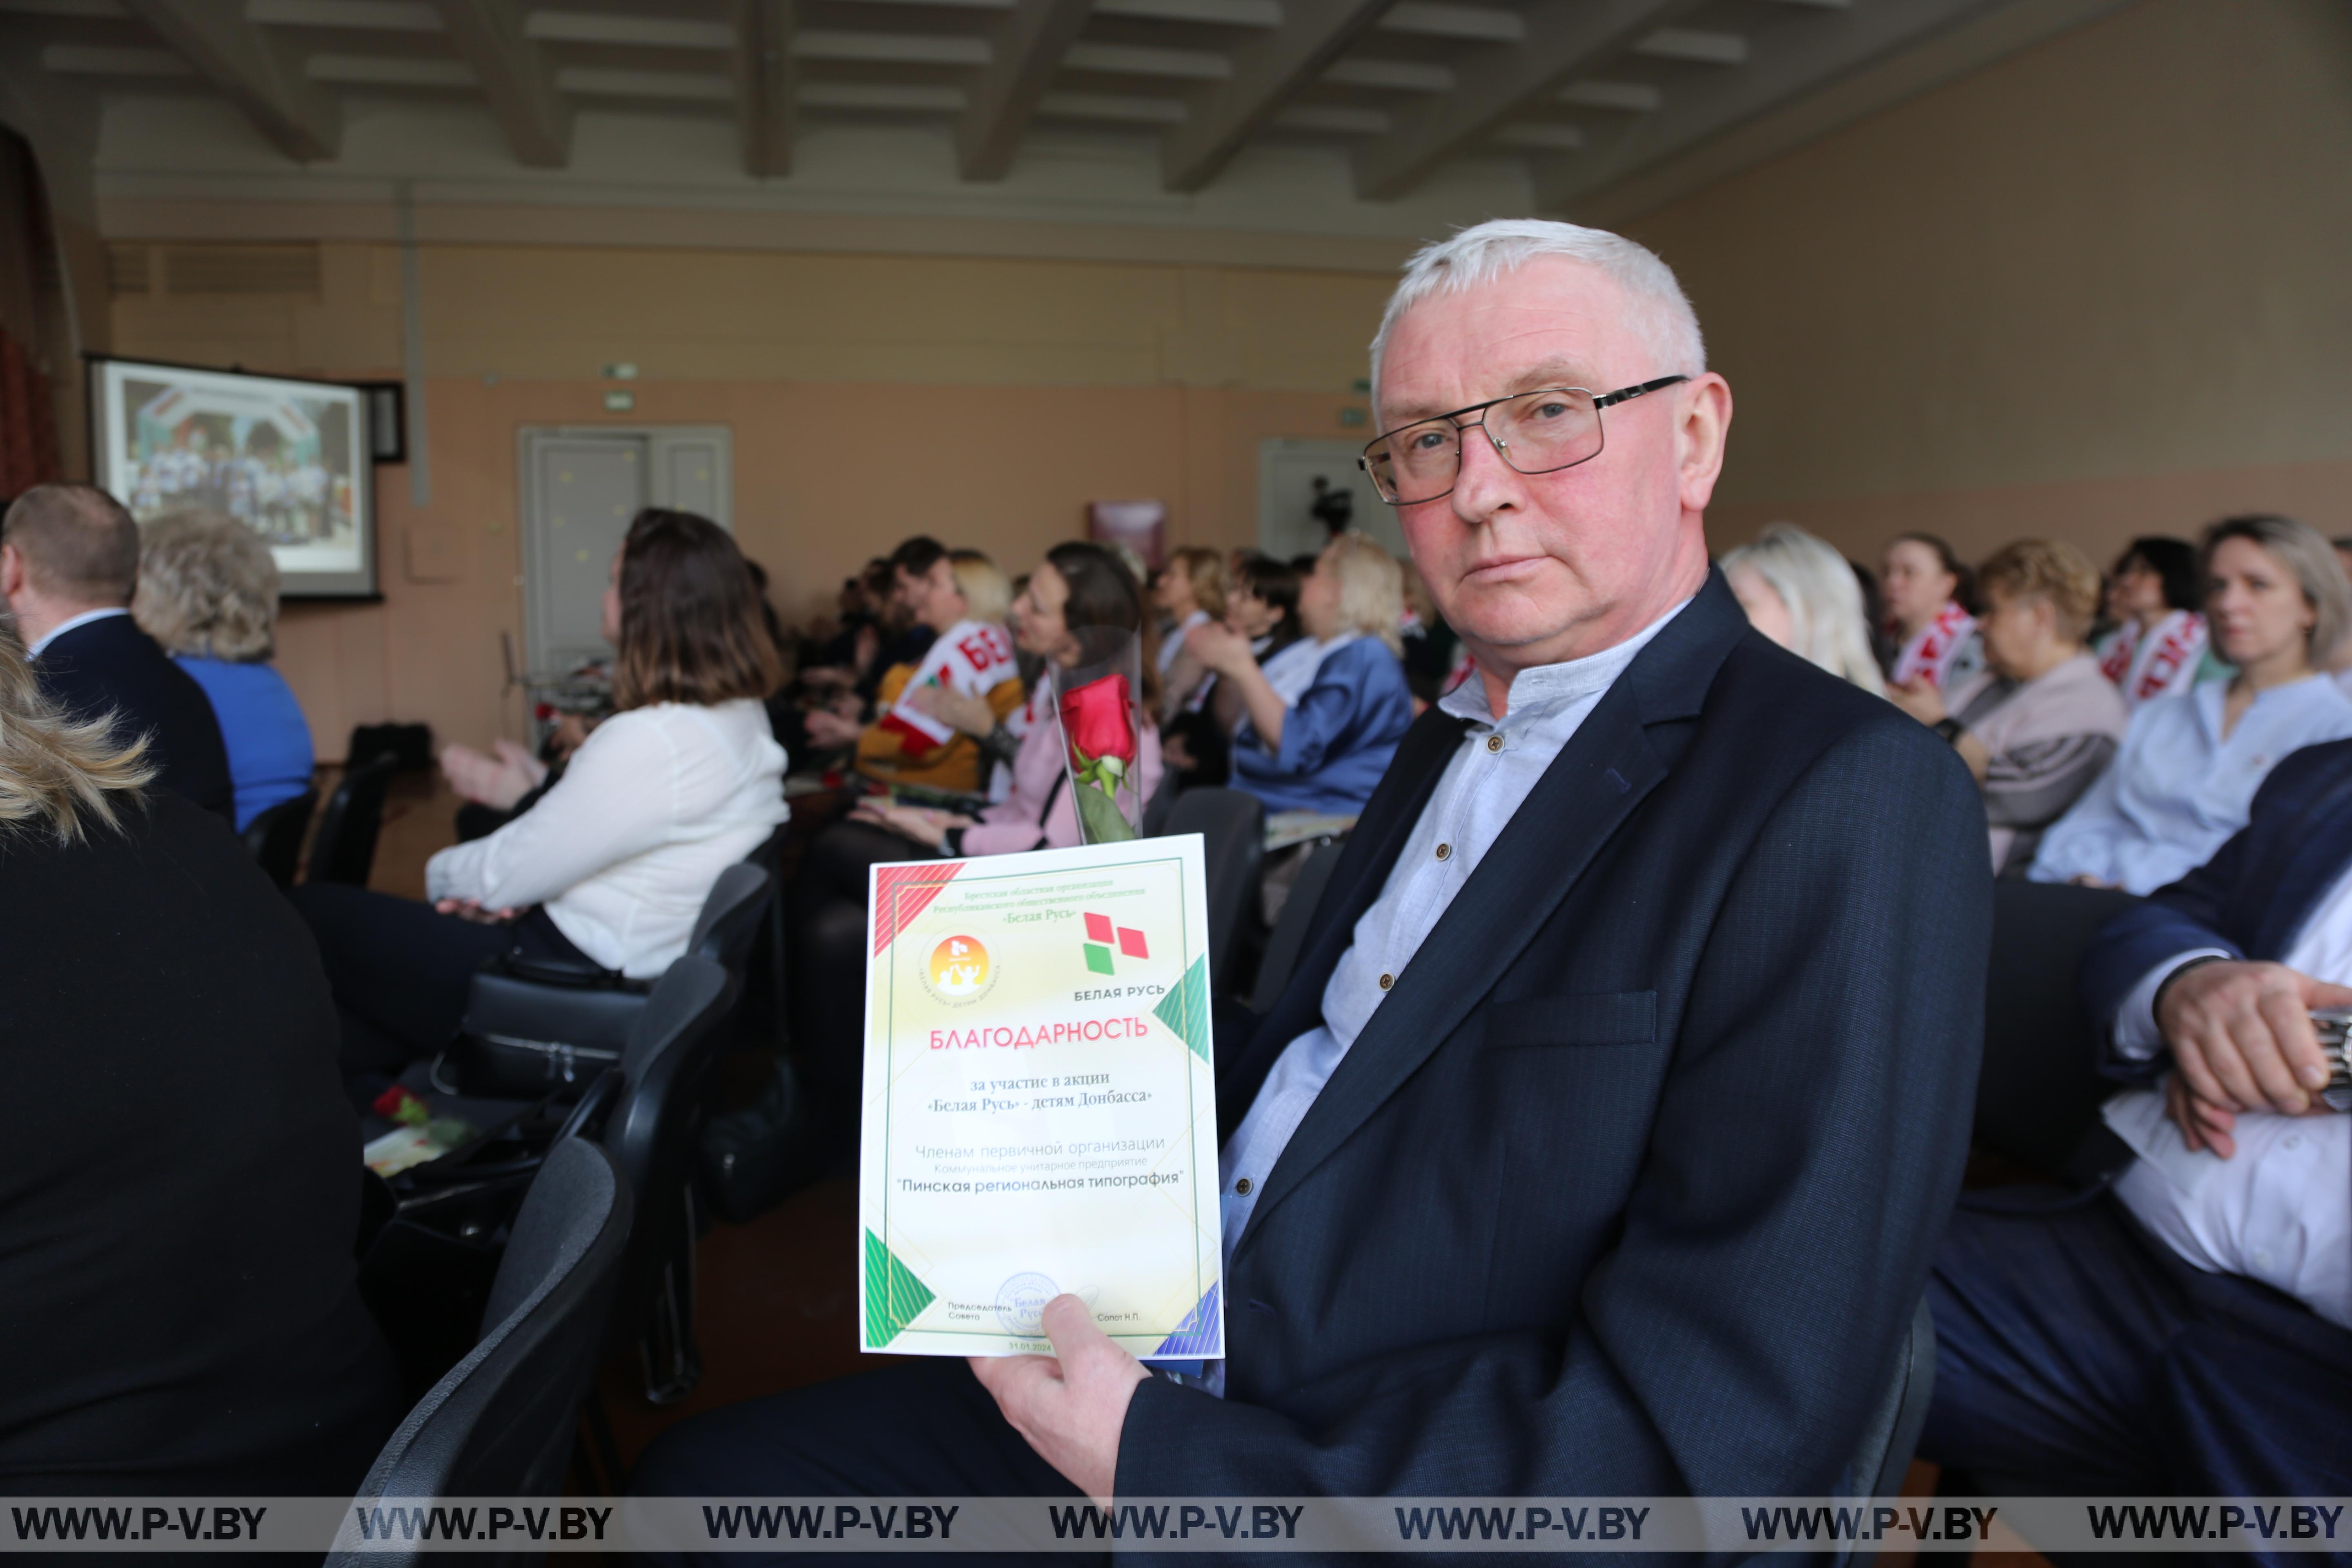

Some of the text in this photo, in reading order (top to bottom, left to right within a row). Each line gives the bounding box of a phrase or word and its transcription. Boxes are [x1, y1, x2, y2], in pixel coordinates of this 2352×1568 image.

[1003, 910, 1076, 924] «Белая Русь»
[1074, 984, 1165, 1002] БЕЛАЯ РУСЬ
[930, 1017, 1148, 1050] БЛАГОДАРНОСТЬ
[970, 1074, 1110, 1094] за участие в акции
[928, 1099, 977, 1112] «Белая
[982, 1098, 1020, 1114] Русь»
[1031, 1096, 1074, 1111] детям
[1078, 1089, 1152, 1108] Донбасса»
[916, 1138, 1165, 1160] Членам первичной организации
[934, 1158, 1147, 1176] Коммунальное унитарное предприятие
[897, 1170, 1184, 1195] "Пинская региональная типография"
[948, 1301, 1012, 1312] Председатель
[949, 1312, 980, 1321] Совета
[1125, 1313, 1140, 1321] Н.П.
[1009, 1342, 1051, 1352] 31.01.2024
